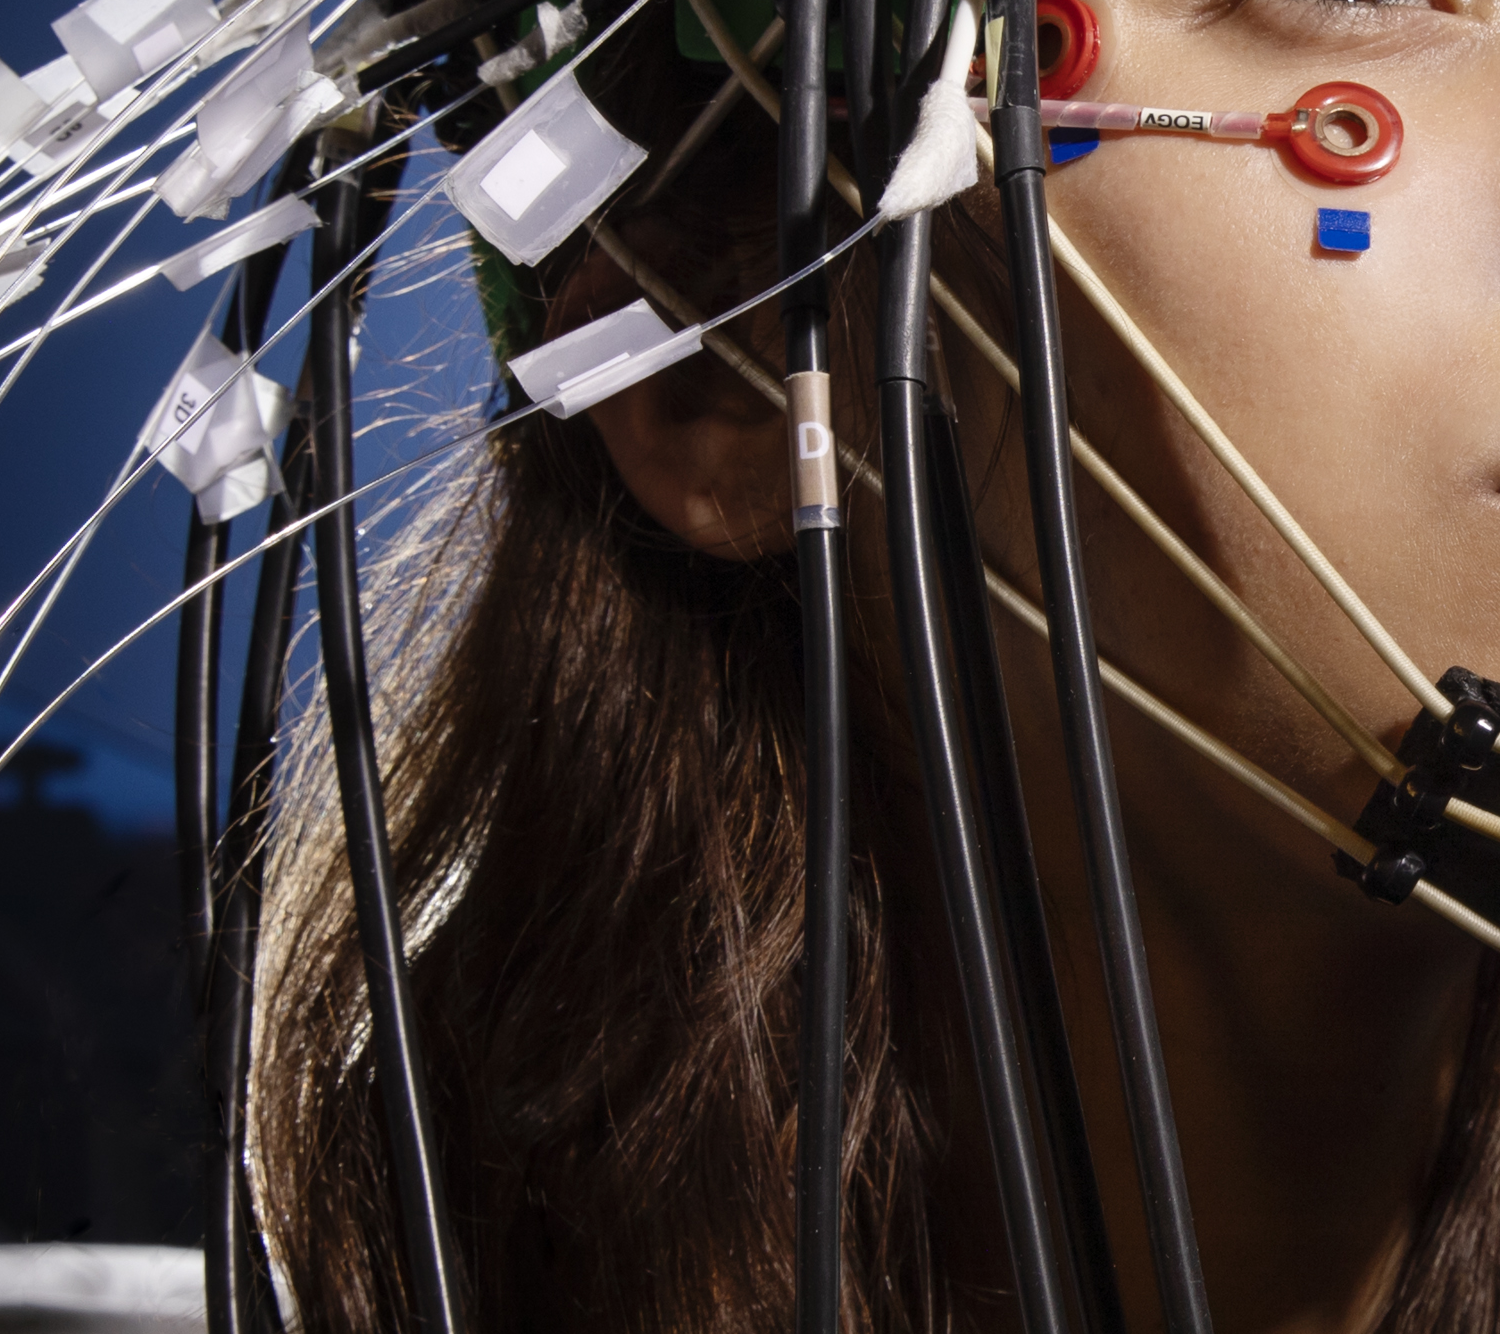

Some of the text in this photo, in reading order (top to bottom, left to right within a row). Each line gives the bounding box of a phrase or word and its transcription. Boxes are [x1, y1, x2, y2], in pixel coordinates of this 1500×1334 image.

[1144, 113, 1203, 130] EOGv
[174, 393, 196, 424] 3D
[798, 422, 830, 459] D
